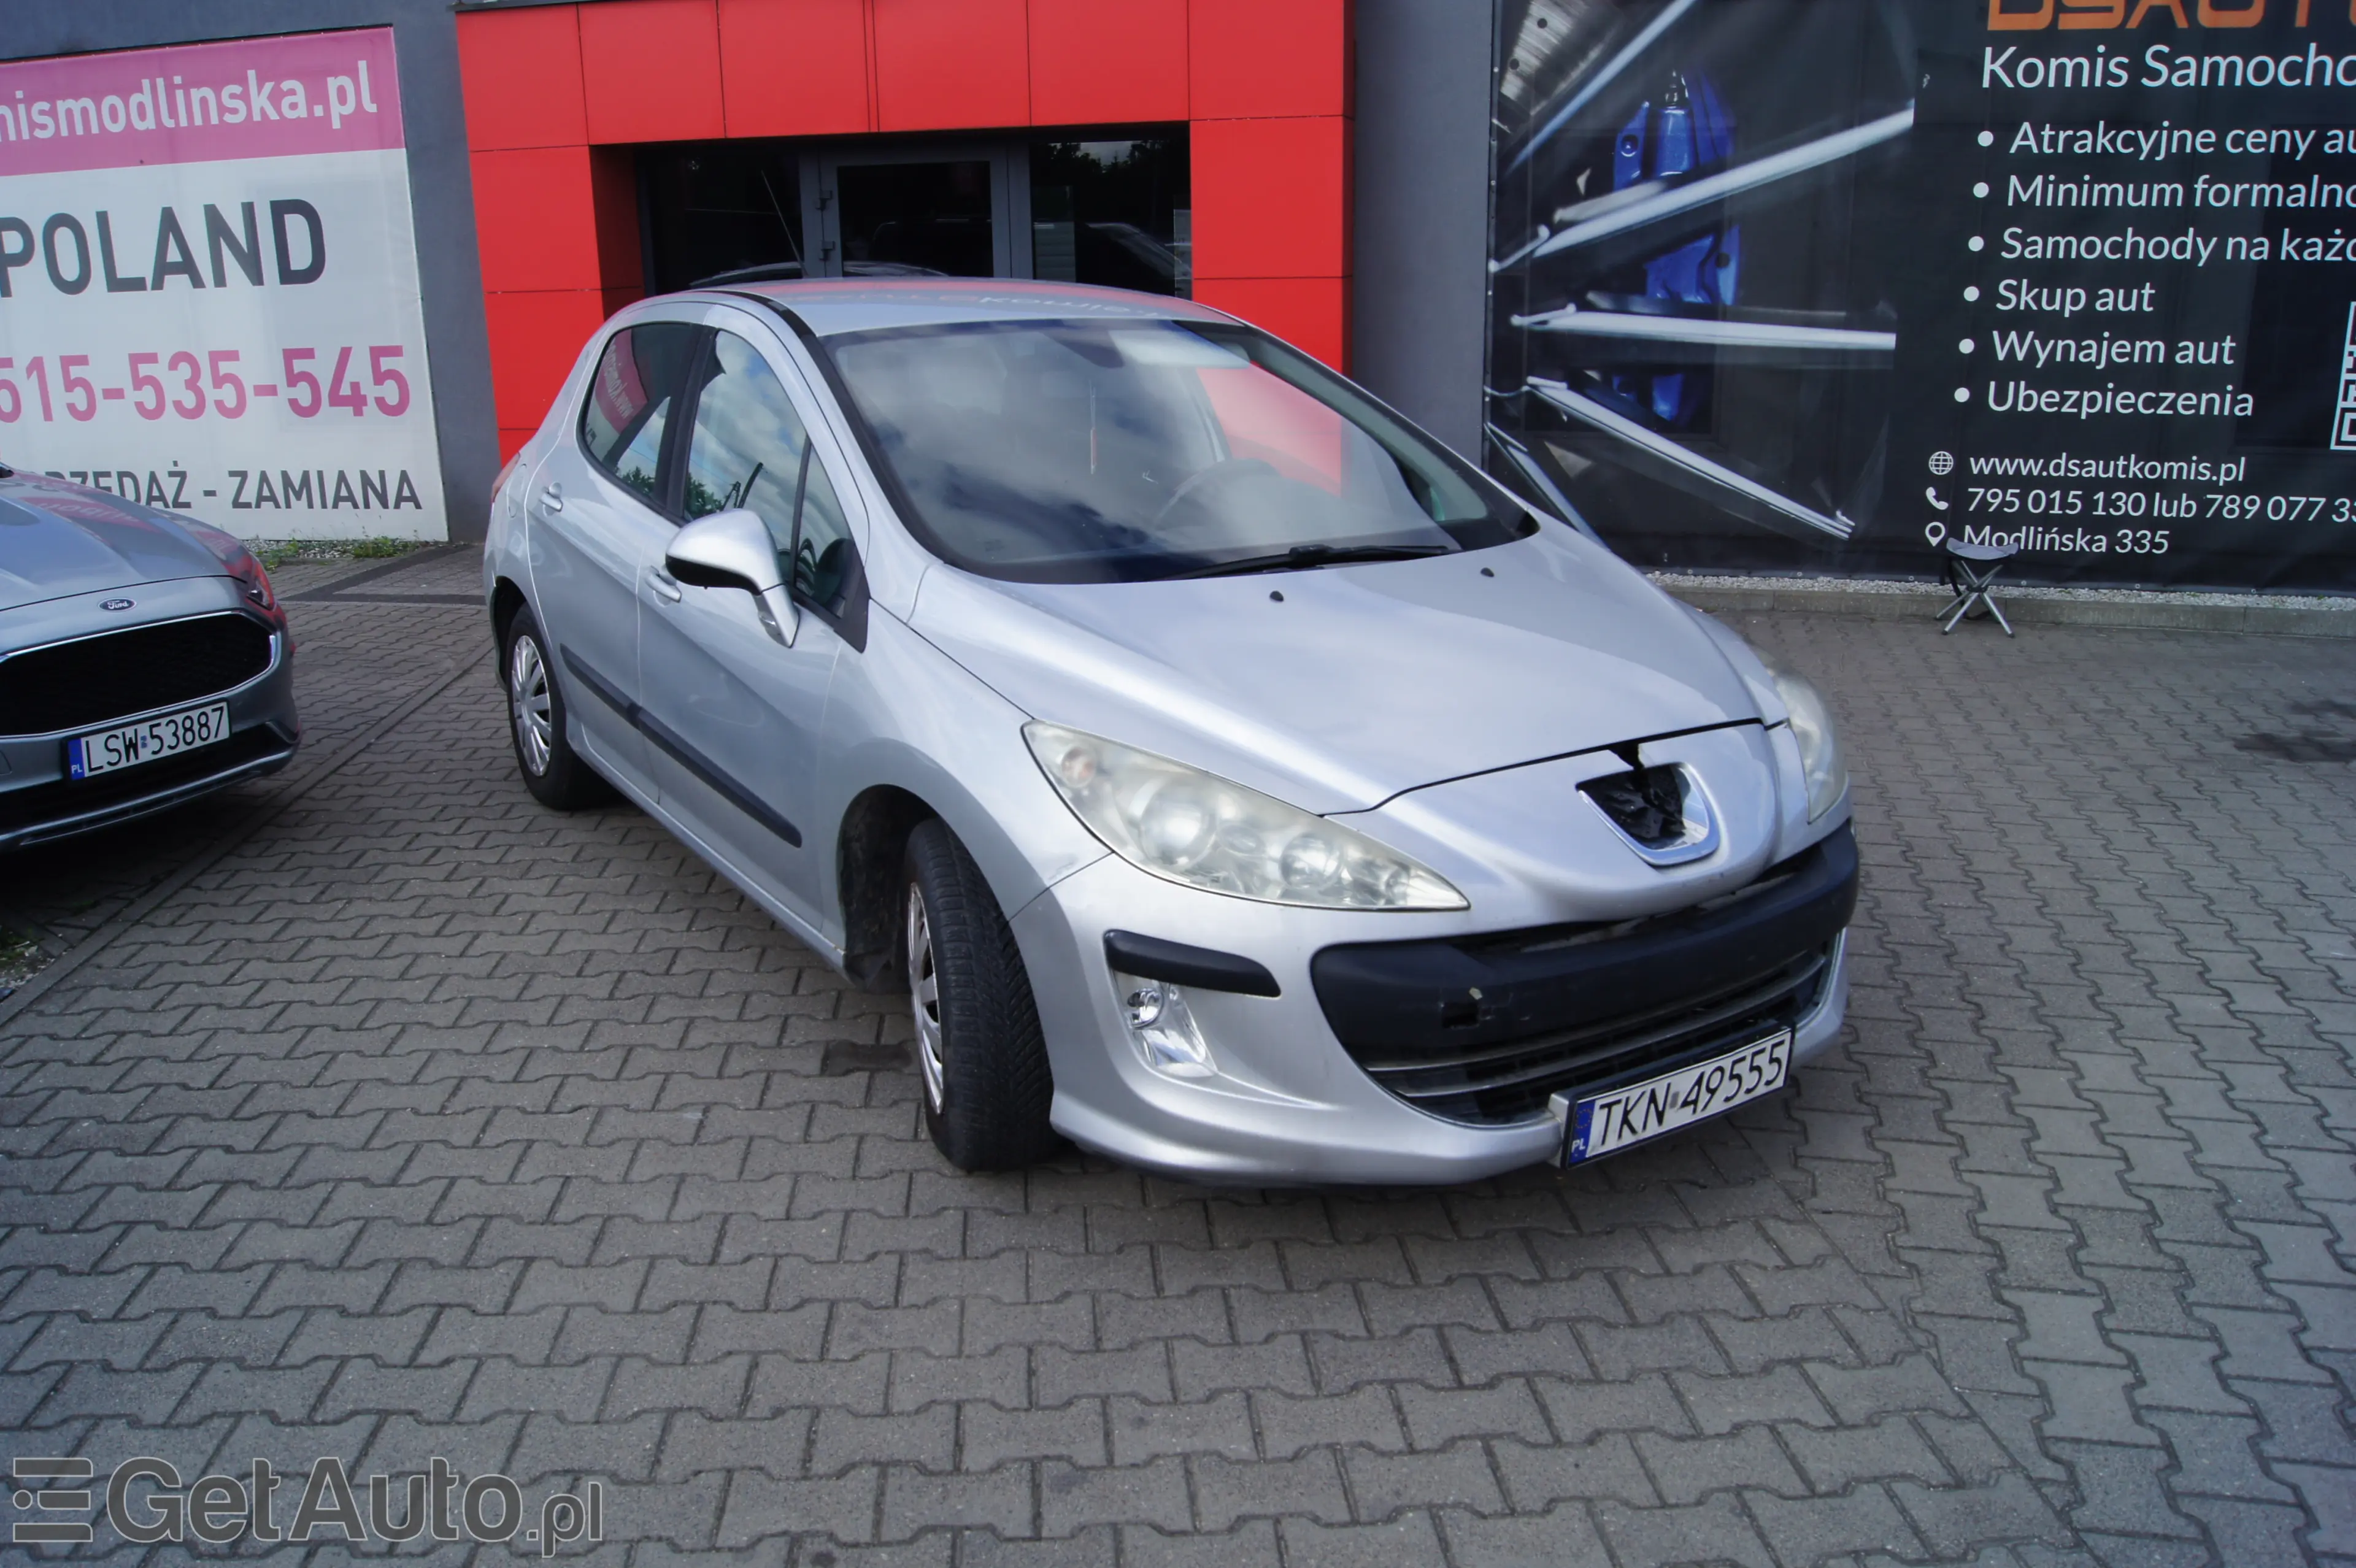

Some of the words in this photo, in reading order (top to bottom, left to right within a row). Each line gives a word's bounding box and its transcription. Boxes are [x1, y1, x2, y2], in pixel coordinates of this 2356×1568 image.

[1982, 45, 2128, 88] Komis
[2141, 42, 2356, 86] Samocho
[2009, 121, 2215, 161] Atrakcyjne
[2225, 128, 2316, 161] ceny
[2008, 174, 2183, 207] Minimum
[0, 199, 326, 298] POLAND
[2001, 227, 2217, 266] Samochody
[2226, 236, 2269, 260] na
[1996, 279, 2085, 317] Skup
[2095, 282, 2155, 312] aut
[1992, 330, 2165, 369] Wynajem
[2174, 335, 2236, 364] aut
[0, 345, 410, 423] 515-535-545
[1987, 381, 2254, 420] Ubezpieczenia
[1969, 452, 2246, 486] www.dsautkomis.pl
[228, 470, 422, 510] ZAMIANA
[1967, 488, 2020, 513] 795
[2027, 490, 2083, 515] 015
[2092, 491, 2146, 517] 130
[2153, 493, 2197, 518] lub
[2206, 494, 2260, 519] 789
[2267, 496, 2326, 521] 077
[2331, 498, 2356, 522] 3
[1963, 525, 2108, 552] Modlińska
[2114, 529, 2170, 554] 335
[85, 728, 139, 772] LSW
[148, 706, 225, 755] 53887
[71, 765, 83, 774] PL
[1599, 1082, 1671, 1146] TKN
[1679, 1040, 1785, 1116] 49555
[1571, 1138, 1586, 1153] PL
